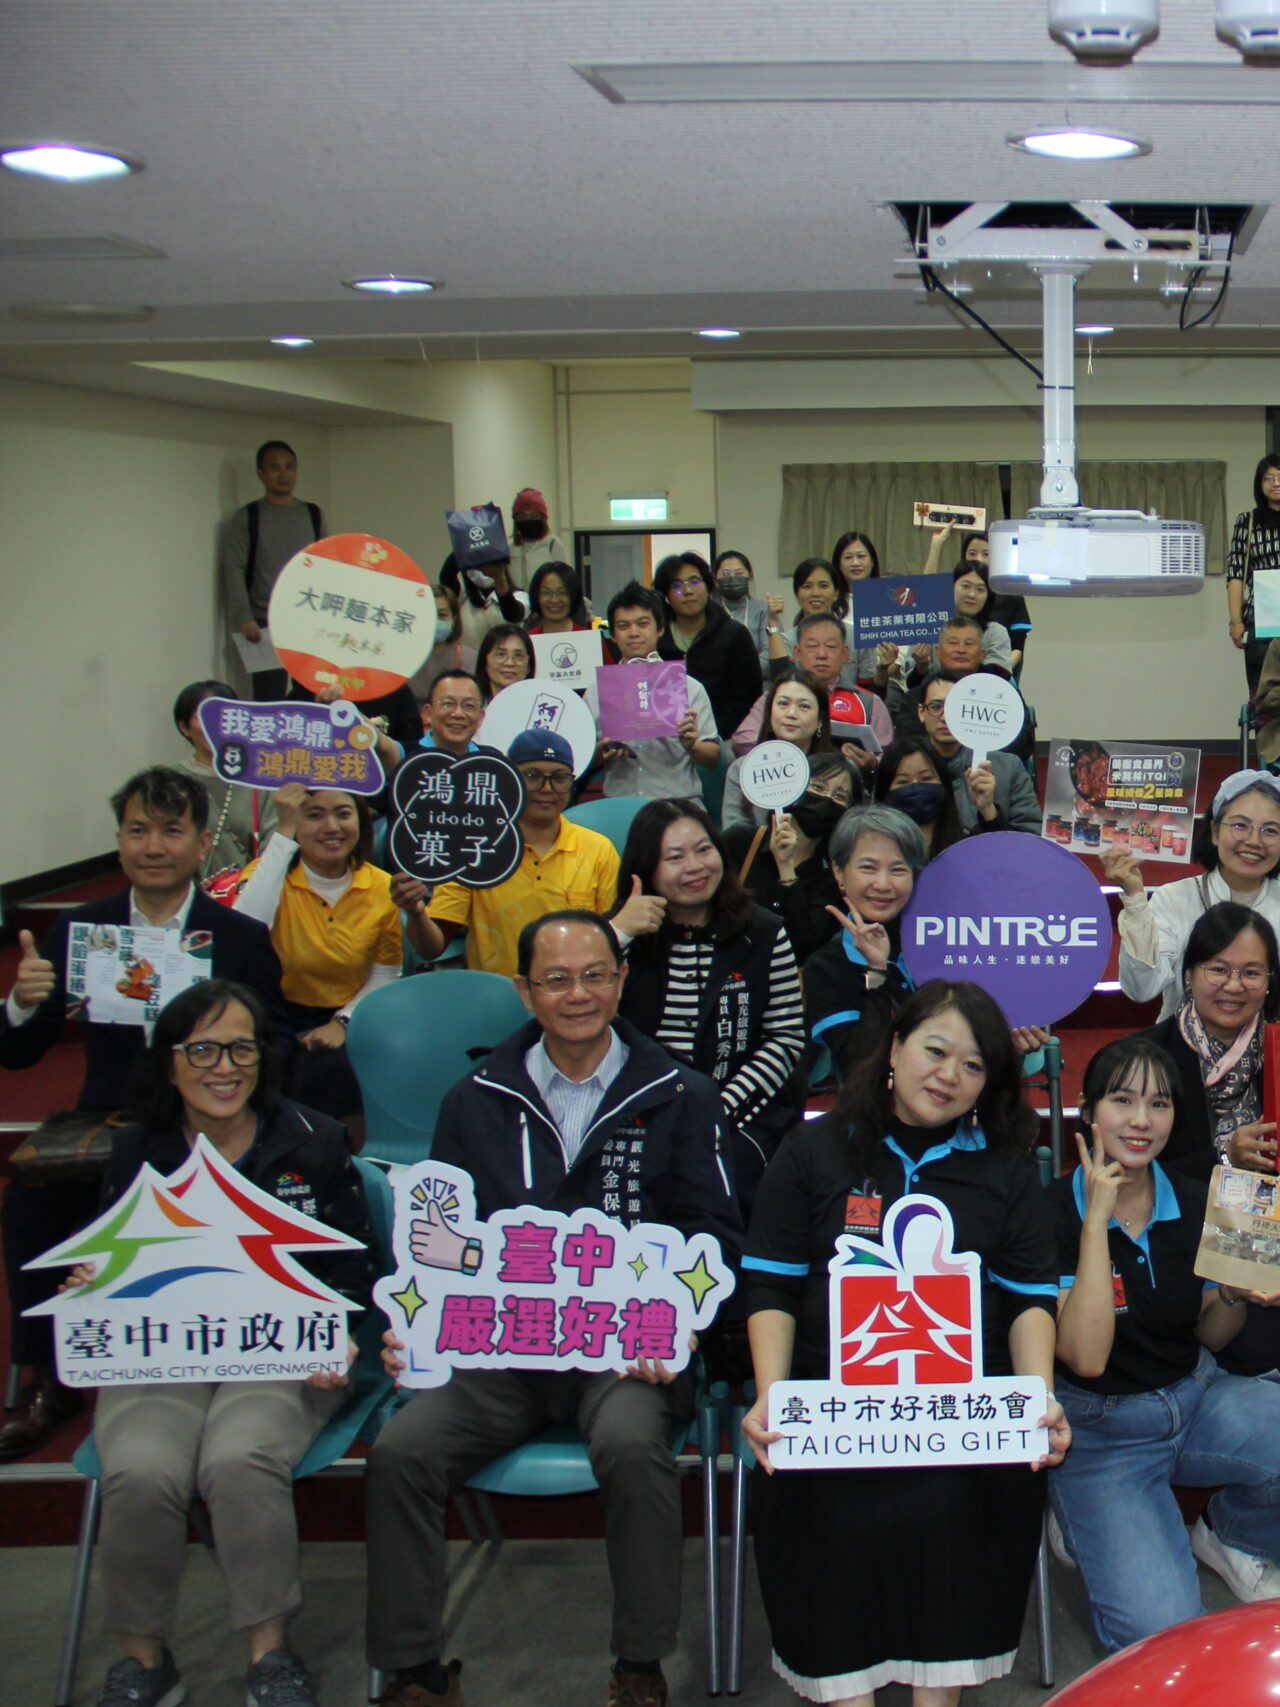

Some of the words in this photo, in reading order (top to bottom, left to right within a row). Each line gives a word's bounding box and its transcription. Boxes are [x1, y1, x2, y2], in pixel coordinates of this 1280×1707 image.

[859, 610, 949, 628] 世佳茶業有限公司
[860, 632, 878, 641] SHIH
[880, 631, 898, 639] CHIA
[221, 707, 333, 749] 我愛鴻鼎
[961, 704, 1007, 724] HWC
[256, 747, 369, 784] 鴻鼎愛我
[753, 763, 796, 785] HWC
[417, 768, 500, 806] 鴻鼎
[415, 830, 497, 868] 菓子
[497, 1221, 615, 1287] 臺中
[65, 1311, 341, 1360] 臺中市政府
[436, 1294, 678, 1361] 嚴選好禮
[65, 1366, 163, 1383] TAICHUNG
[167, 1365, 211, 1380] CITY
[214, 1361, 345, 1377] GOVERNMENT
[779, 1390, 1033, 1425] 臺中市好禮協會
[783, 1432, 946, 1456] TAICHUNG
[961, 1429, 1032, 1451] GIFT
